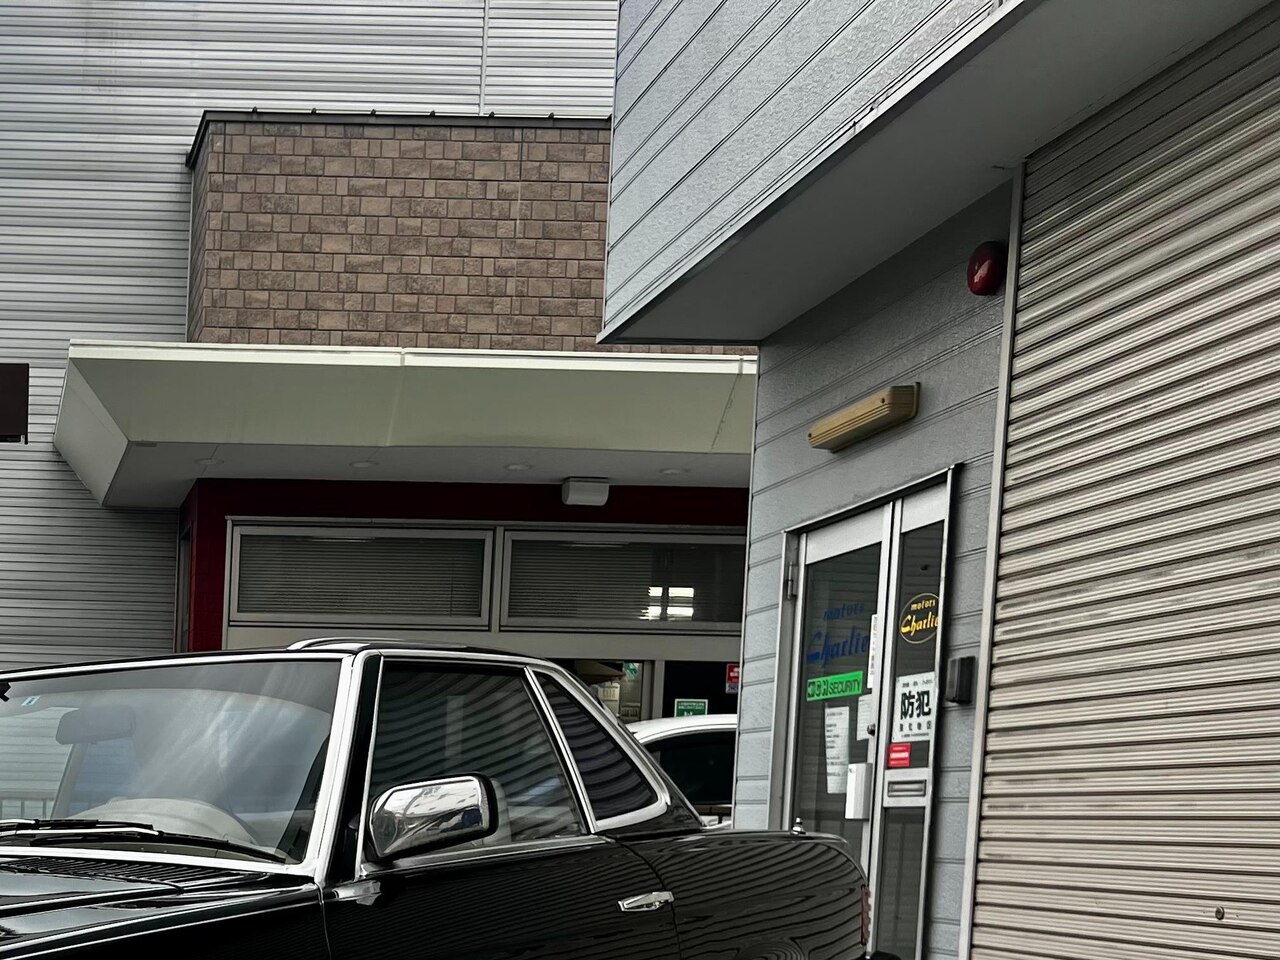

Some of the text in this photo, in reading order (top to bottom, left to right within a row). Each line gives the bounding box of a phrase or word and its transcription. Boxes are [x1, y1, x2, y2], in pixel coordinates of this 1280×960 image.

[824, 603, 865, 621] motors
[911, 599, 936, 611] motors
[901, 612, 939, 637] Charlie
[806, 625, 870, 669] Charlie
[829, 678, 861, 695] SECURITY
[900, 690, 931, 720] 防犯
